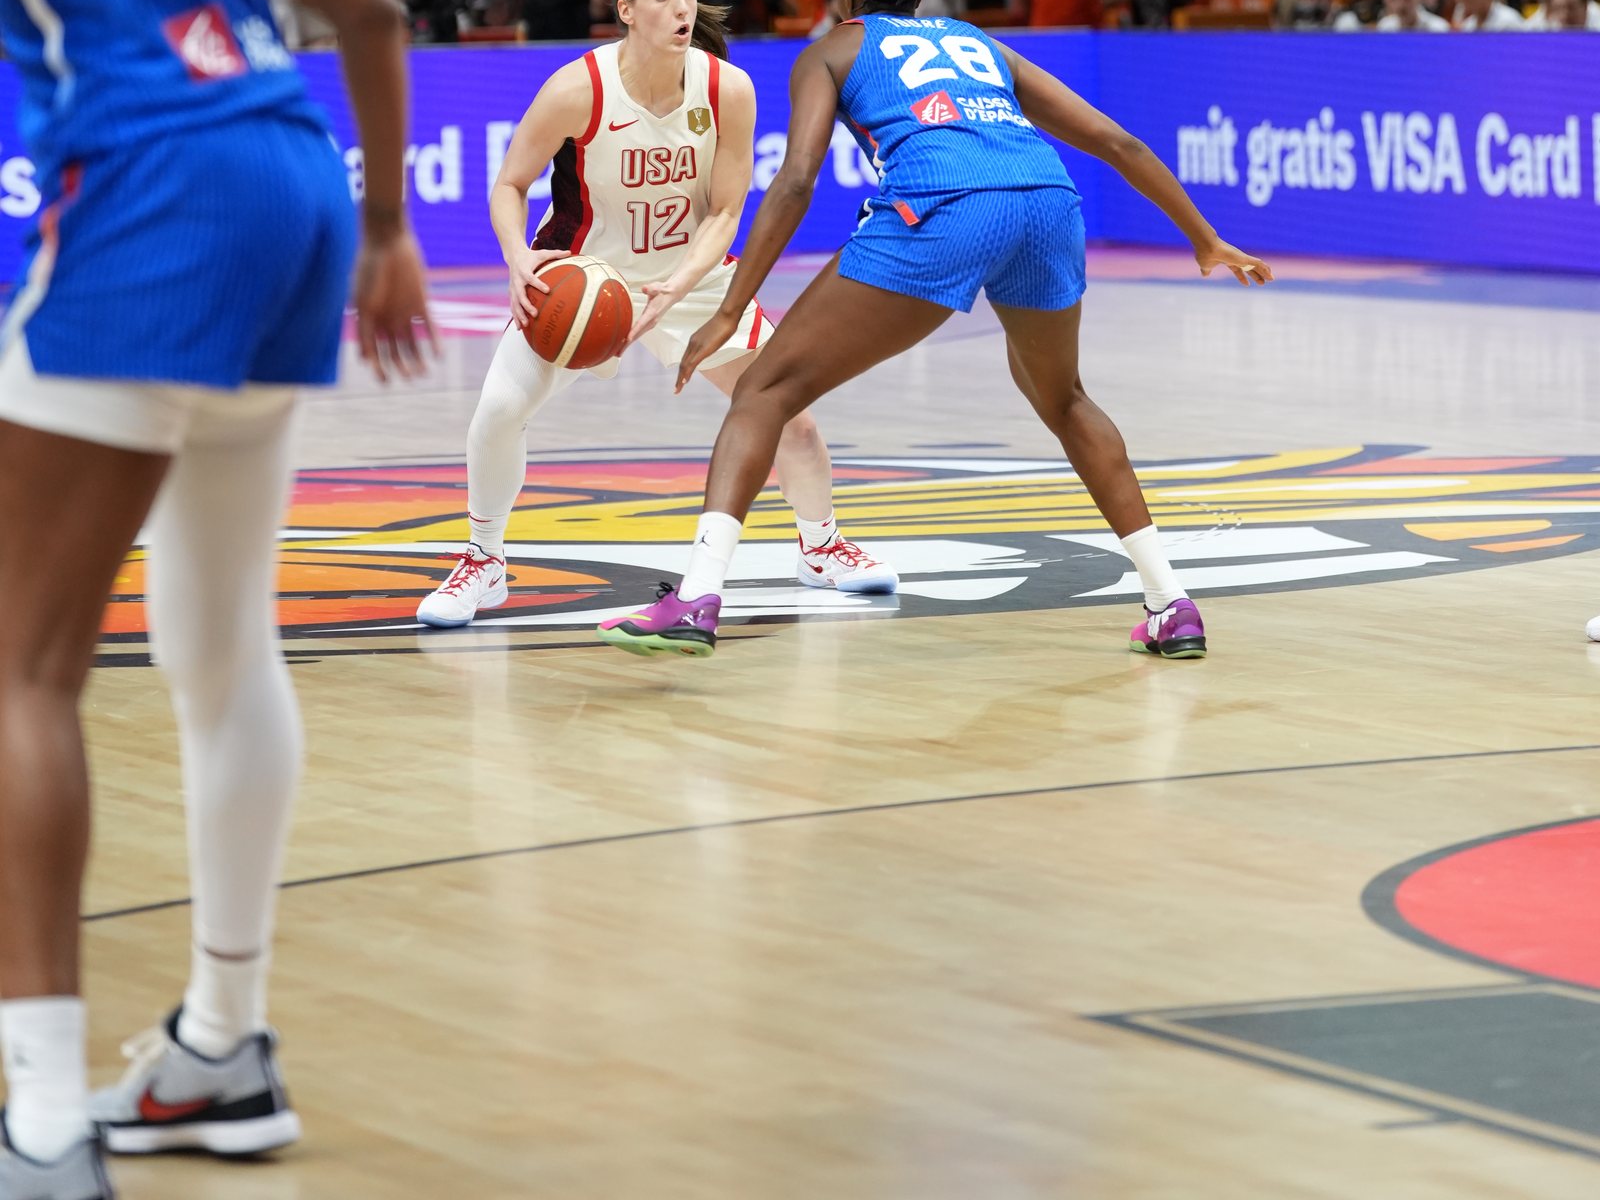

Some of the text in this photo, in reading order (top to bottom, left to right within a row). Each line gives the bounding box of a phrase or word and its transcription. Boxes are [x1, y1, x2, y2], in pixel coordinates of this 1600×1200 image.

[879, 35, 1005, 90] 28
[956, 97, 1013, 111] CAISSE
[621, 146, 697, 188] USA
[1177, 104, 1239, 187] mit
[1246, 107, 1357, 206] gratis
[1361, 110, 1467, 194] VISA
[1475, 111, 1582, 198] Card
[627, 196, 691, 254] 12
